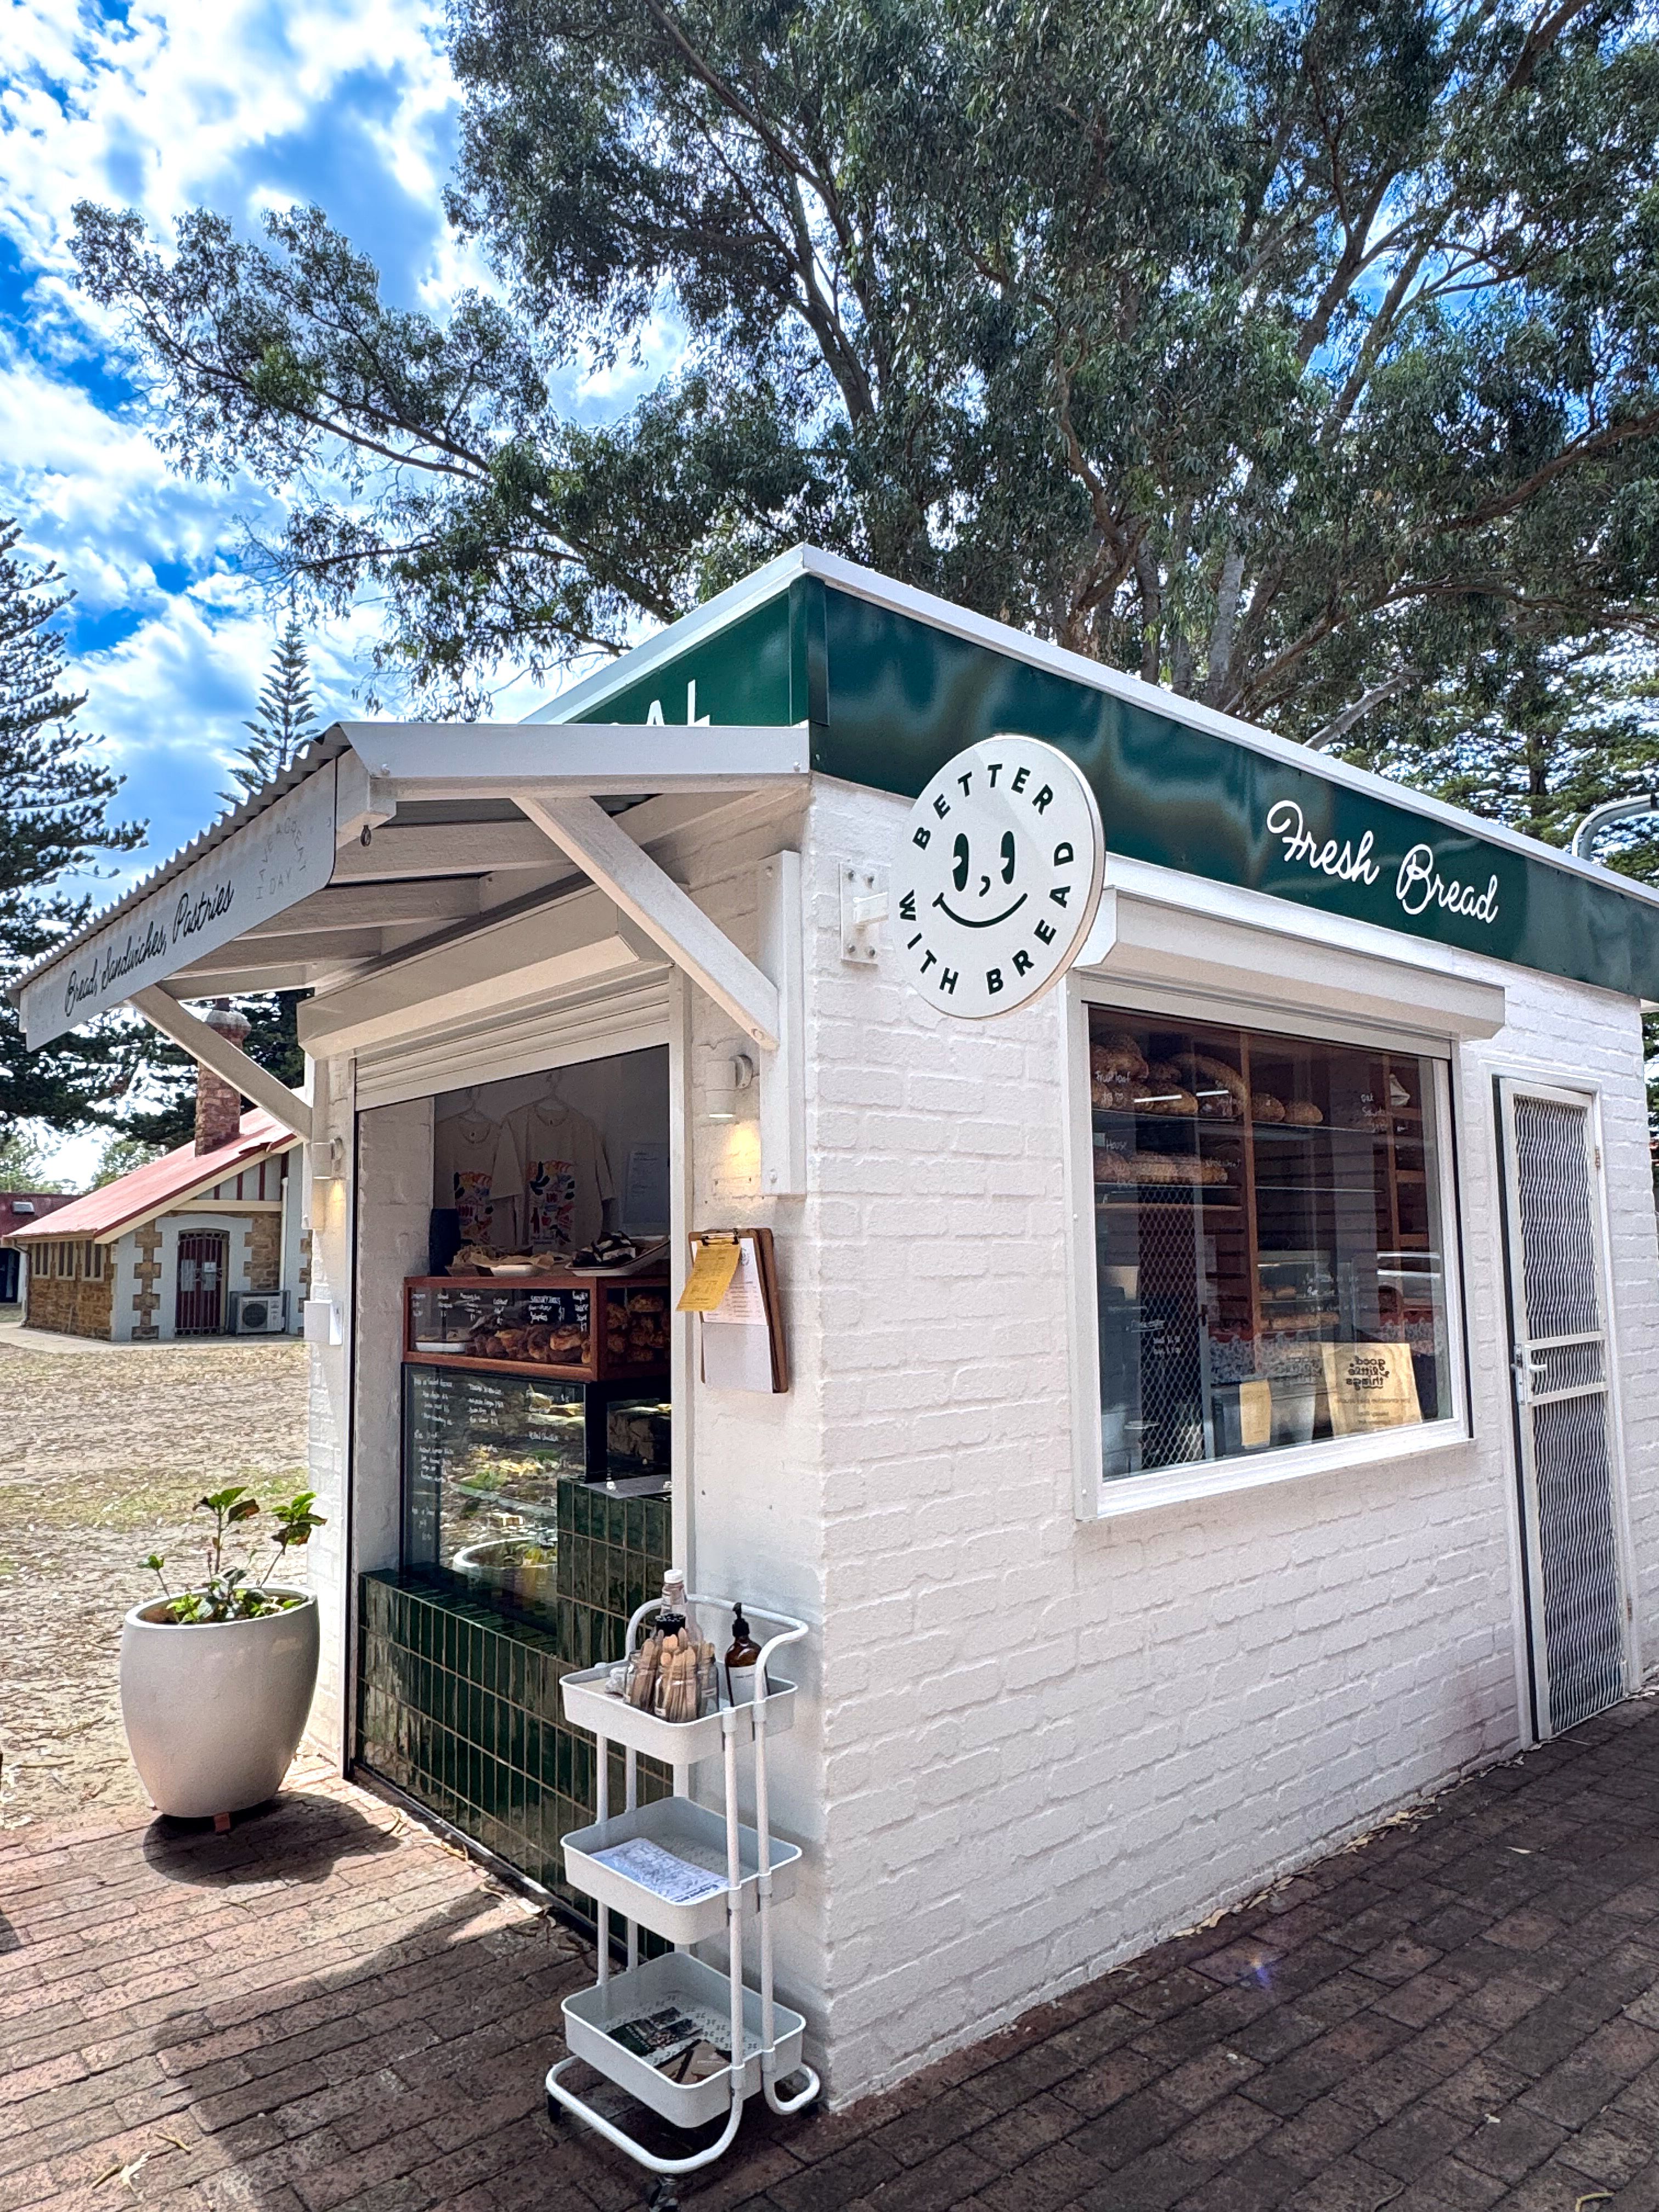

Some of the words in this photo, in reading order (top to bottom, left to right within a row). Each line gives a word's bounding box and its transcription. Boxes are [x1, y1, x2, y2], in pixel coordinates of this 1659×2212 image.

[912, 763, 1055, 850] BETTER
[1266, 799, 1380, 886] Fresh
[1396, 843, 1499, 924] Bread
[101, 921, 167, 992] Sandwiches,
[172, 879, 235, 944] Pastries
[269, 867, 292, 895] DAY
[899, 889, 960, 995] WITH
[986, 841, 1075, 995] BREAD
